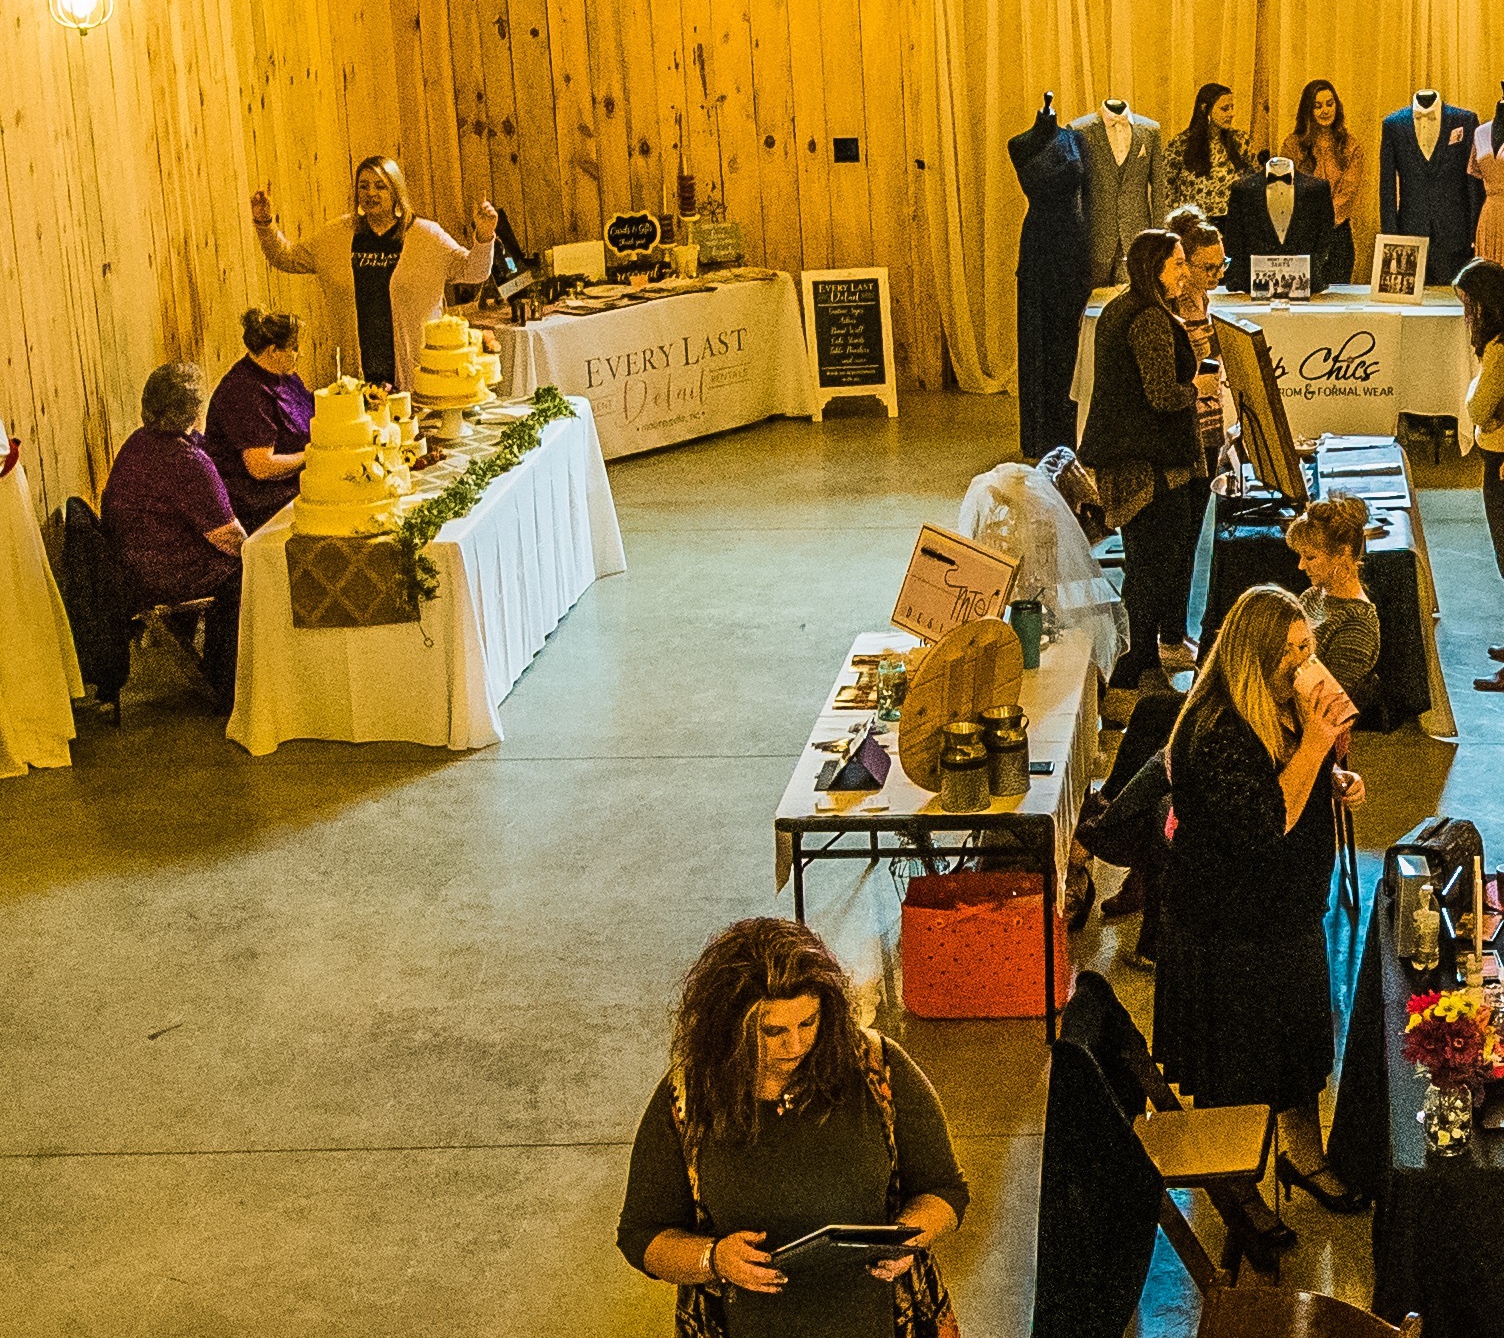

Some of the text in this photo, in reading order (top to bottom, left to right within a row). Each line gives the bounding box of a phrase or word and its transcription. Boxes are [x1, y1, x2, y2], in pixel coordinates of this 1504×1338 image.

[818, 283, 873, 294] EVERY LAST
[830, 291, 860, 303] Detail
[584, 328, 749, 389] EVERY LAST
[1299, 331, 1380, 382] Chics
[615, 368, 704, 428] Detail
[1279, 383, 1394, 401] ROM & FORMAL WEAR
